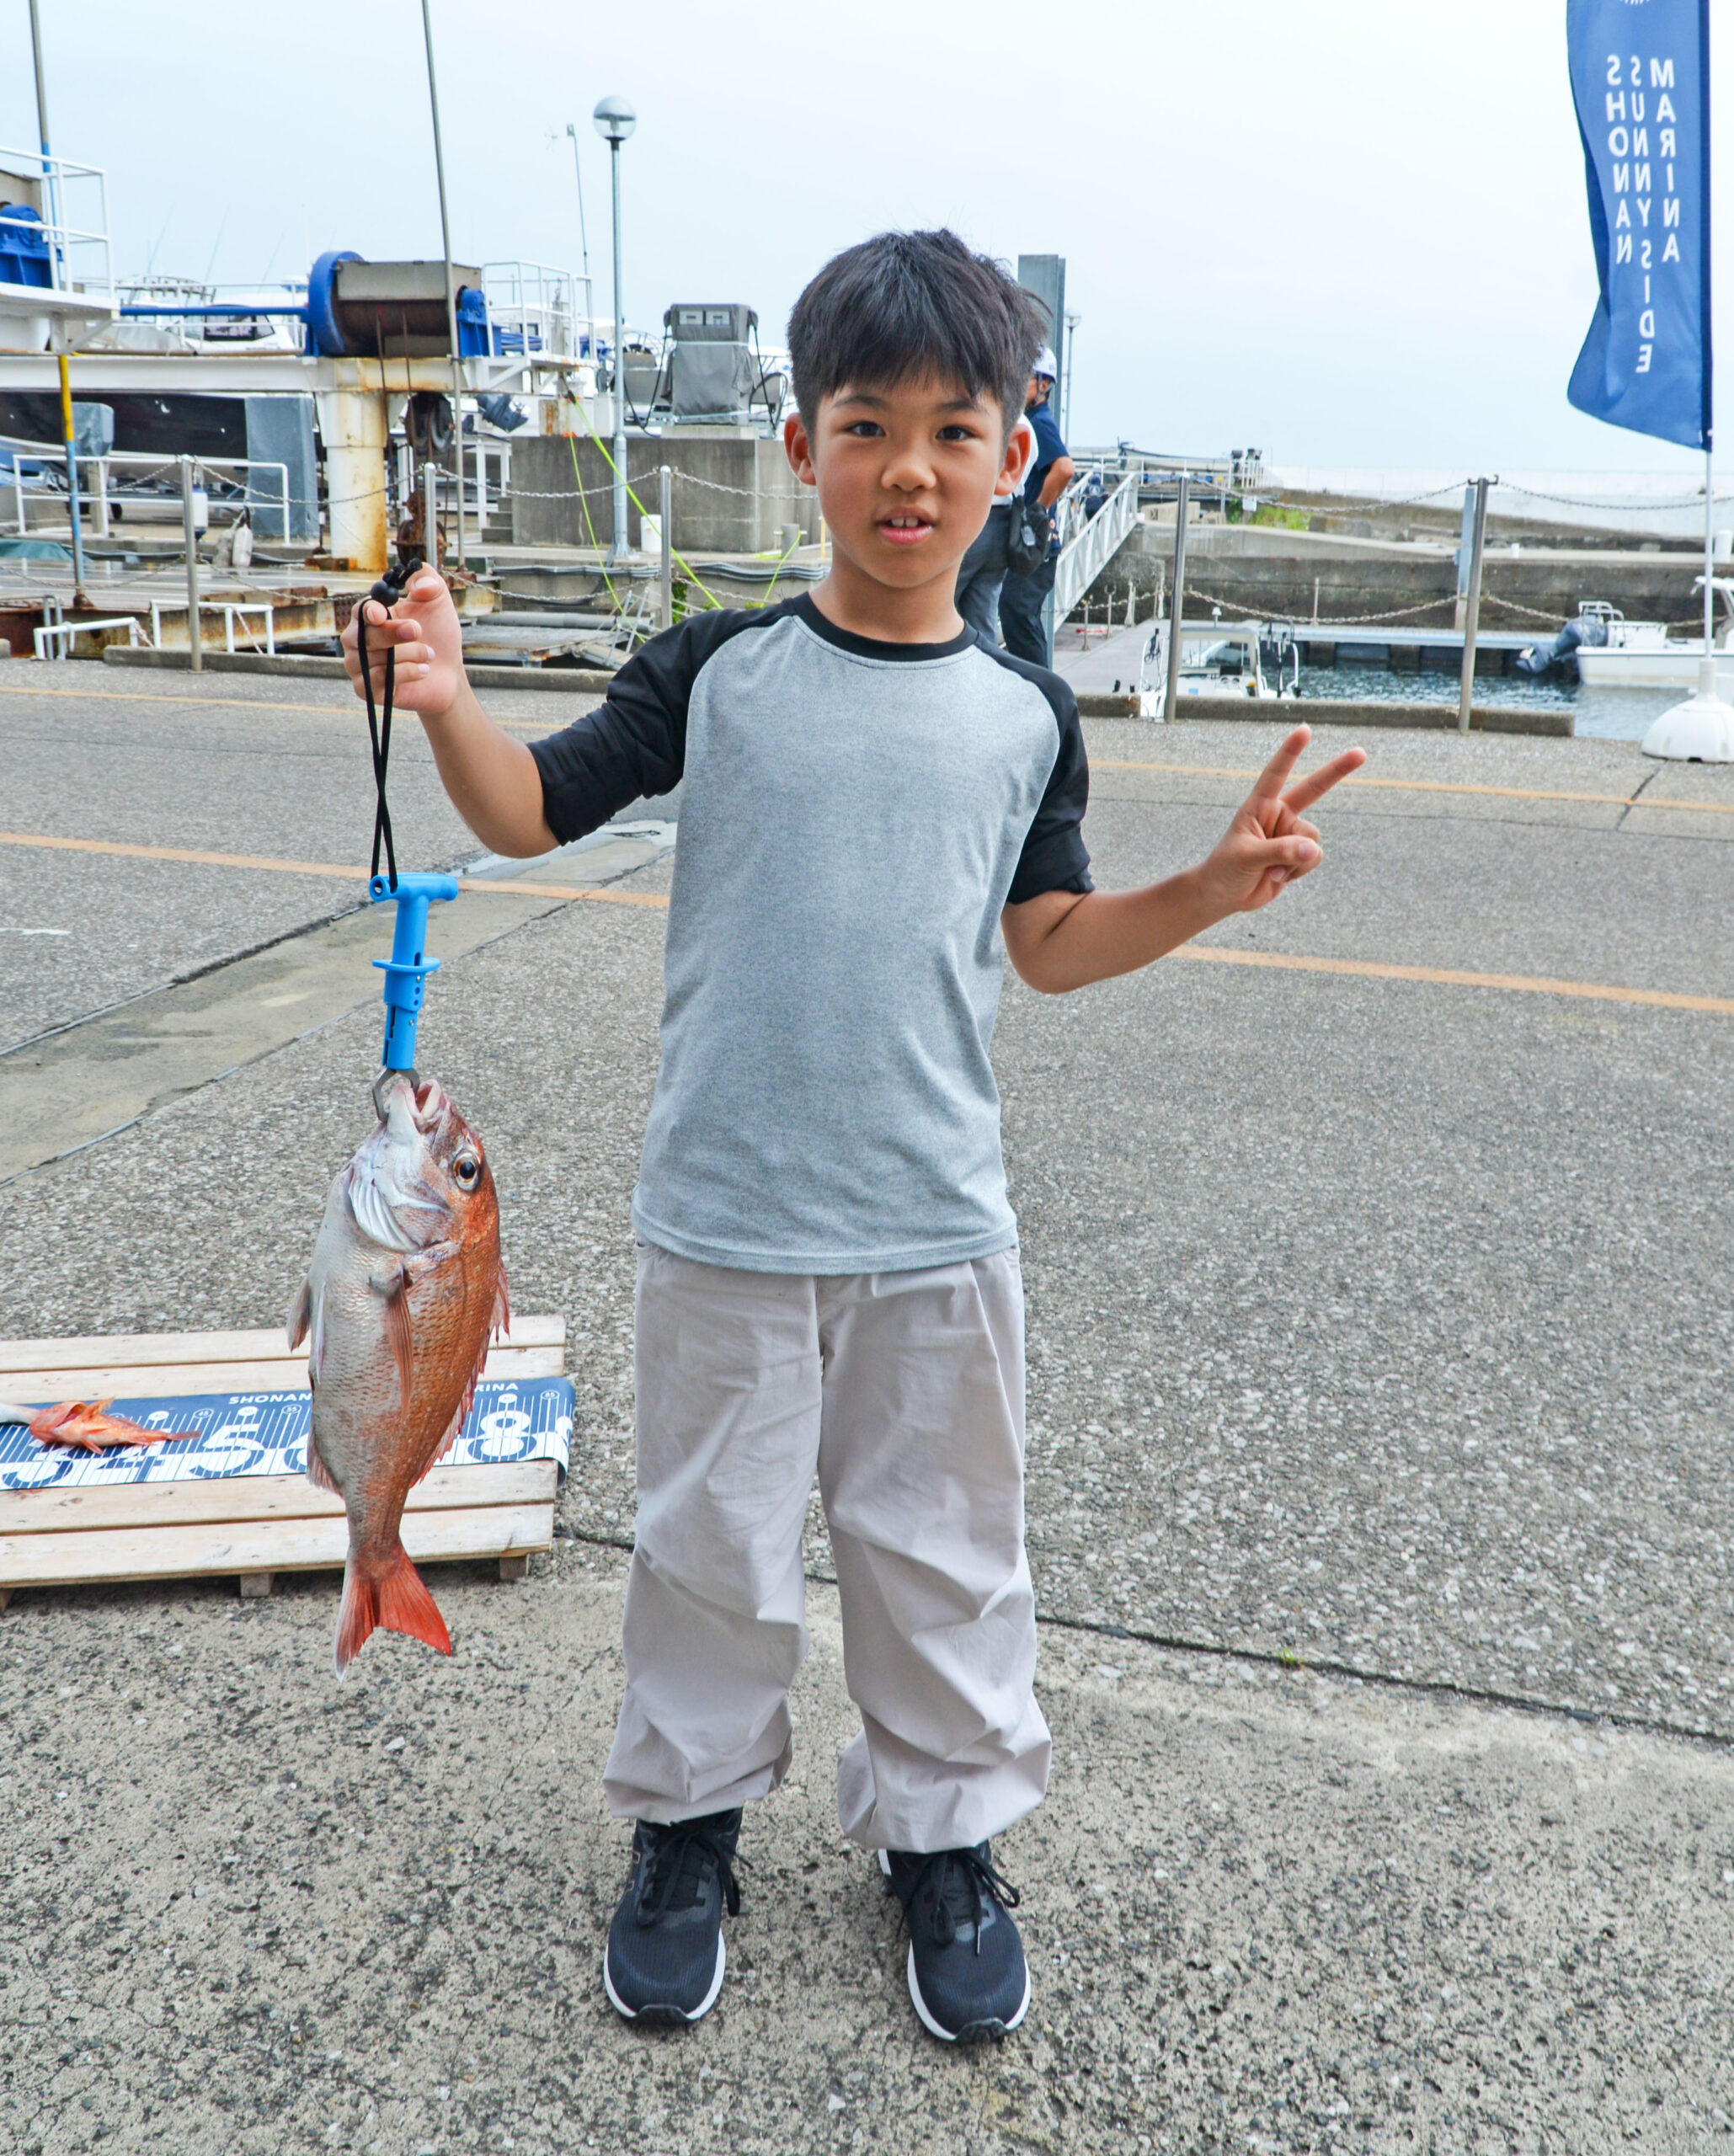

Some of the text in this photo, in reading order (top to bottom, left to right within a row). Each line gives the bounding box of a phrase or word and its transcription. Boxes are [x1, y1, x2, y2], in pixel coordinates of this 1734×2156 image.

[229, 1383, 519, 1405] SHONAN RINA
[189, 1423, 265, 1478] 5
[467, 1410, 537, 1463] 8
